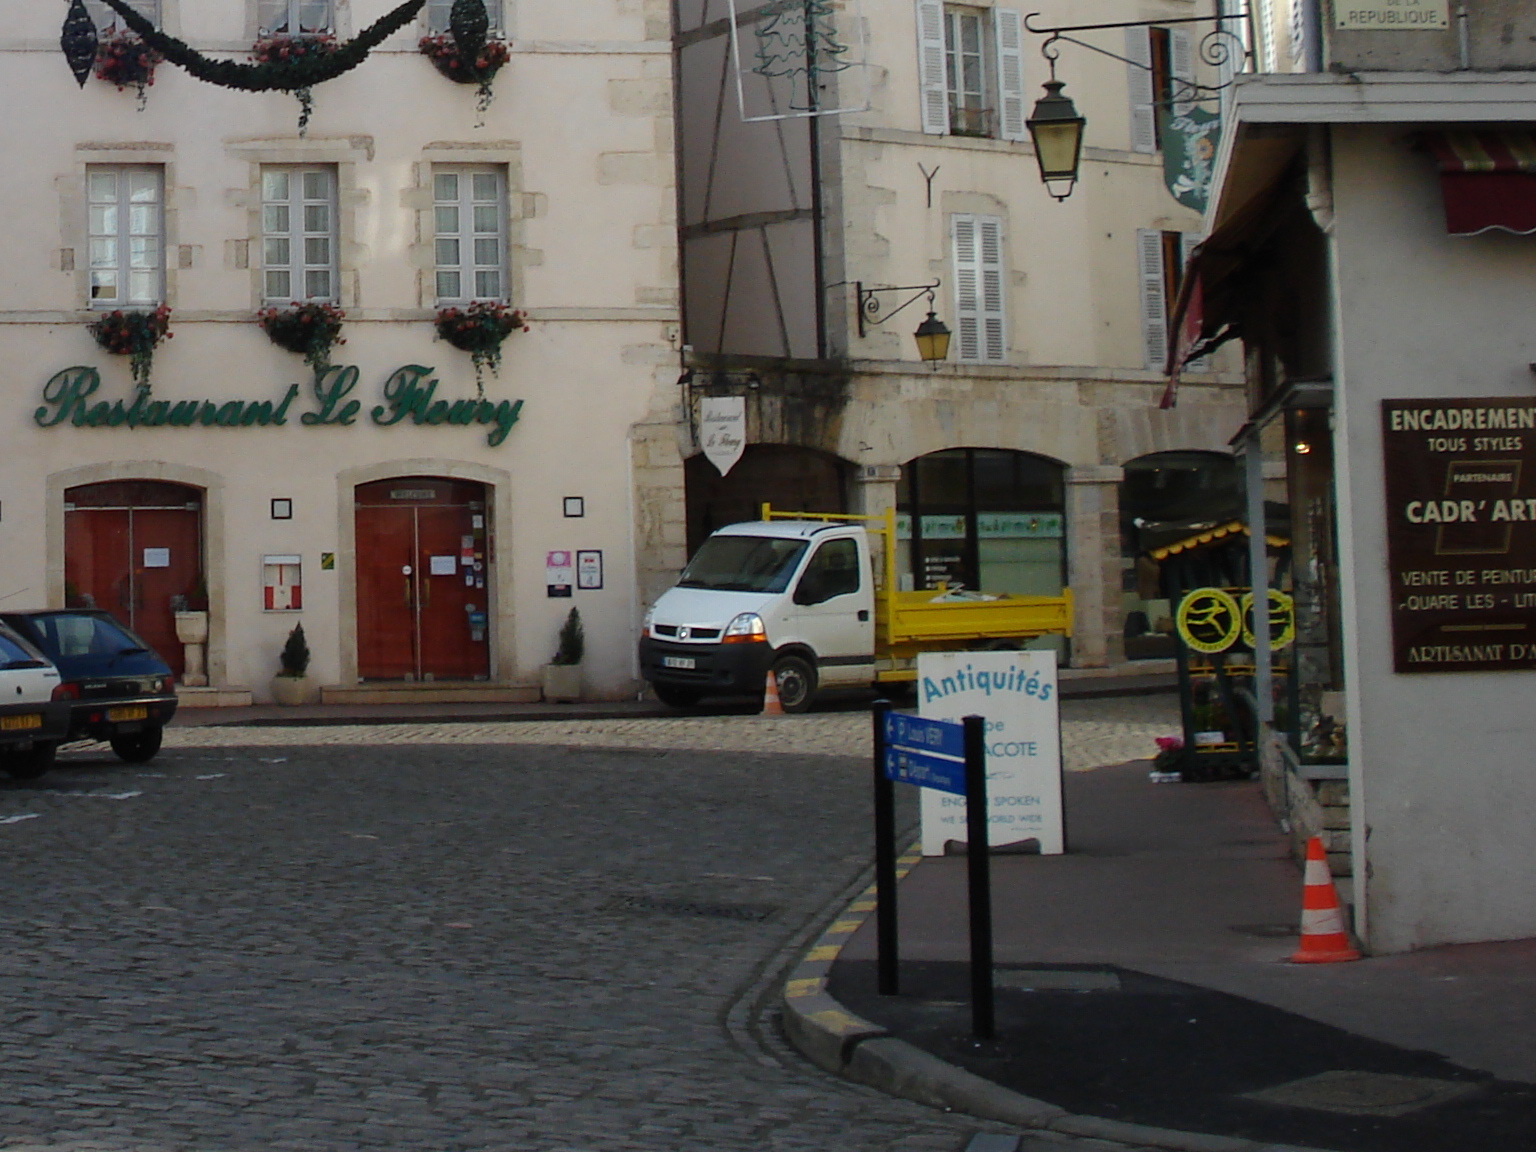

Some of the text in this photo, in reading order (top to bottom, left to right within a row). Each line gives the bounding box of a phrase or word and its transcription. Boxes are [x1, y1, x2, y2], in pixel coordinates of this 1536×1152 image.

[1349, 10, 1437, 24] REPUBLIQUE
[33, 364, 524, 447] Restaurant Le Fleury
[1428, 437, 1523, 452] TOUS STYLES
[1453, 473, 1512, 483] PARTENAIRE
[1491, 499, 1536, 522] ART
[1402, 571, 1449, 586] VENTE
[1455, 570, 1476, 585] DE
[1408, 645, 1503, 663] ARTISANAT
[923, 664, 1052, 703] Antiquités
[994, 796, 1040, 806] SPOKEN
[1019, 815, 1042, 823] WIDE
